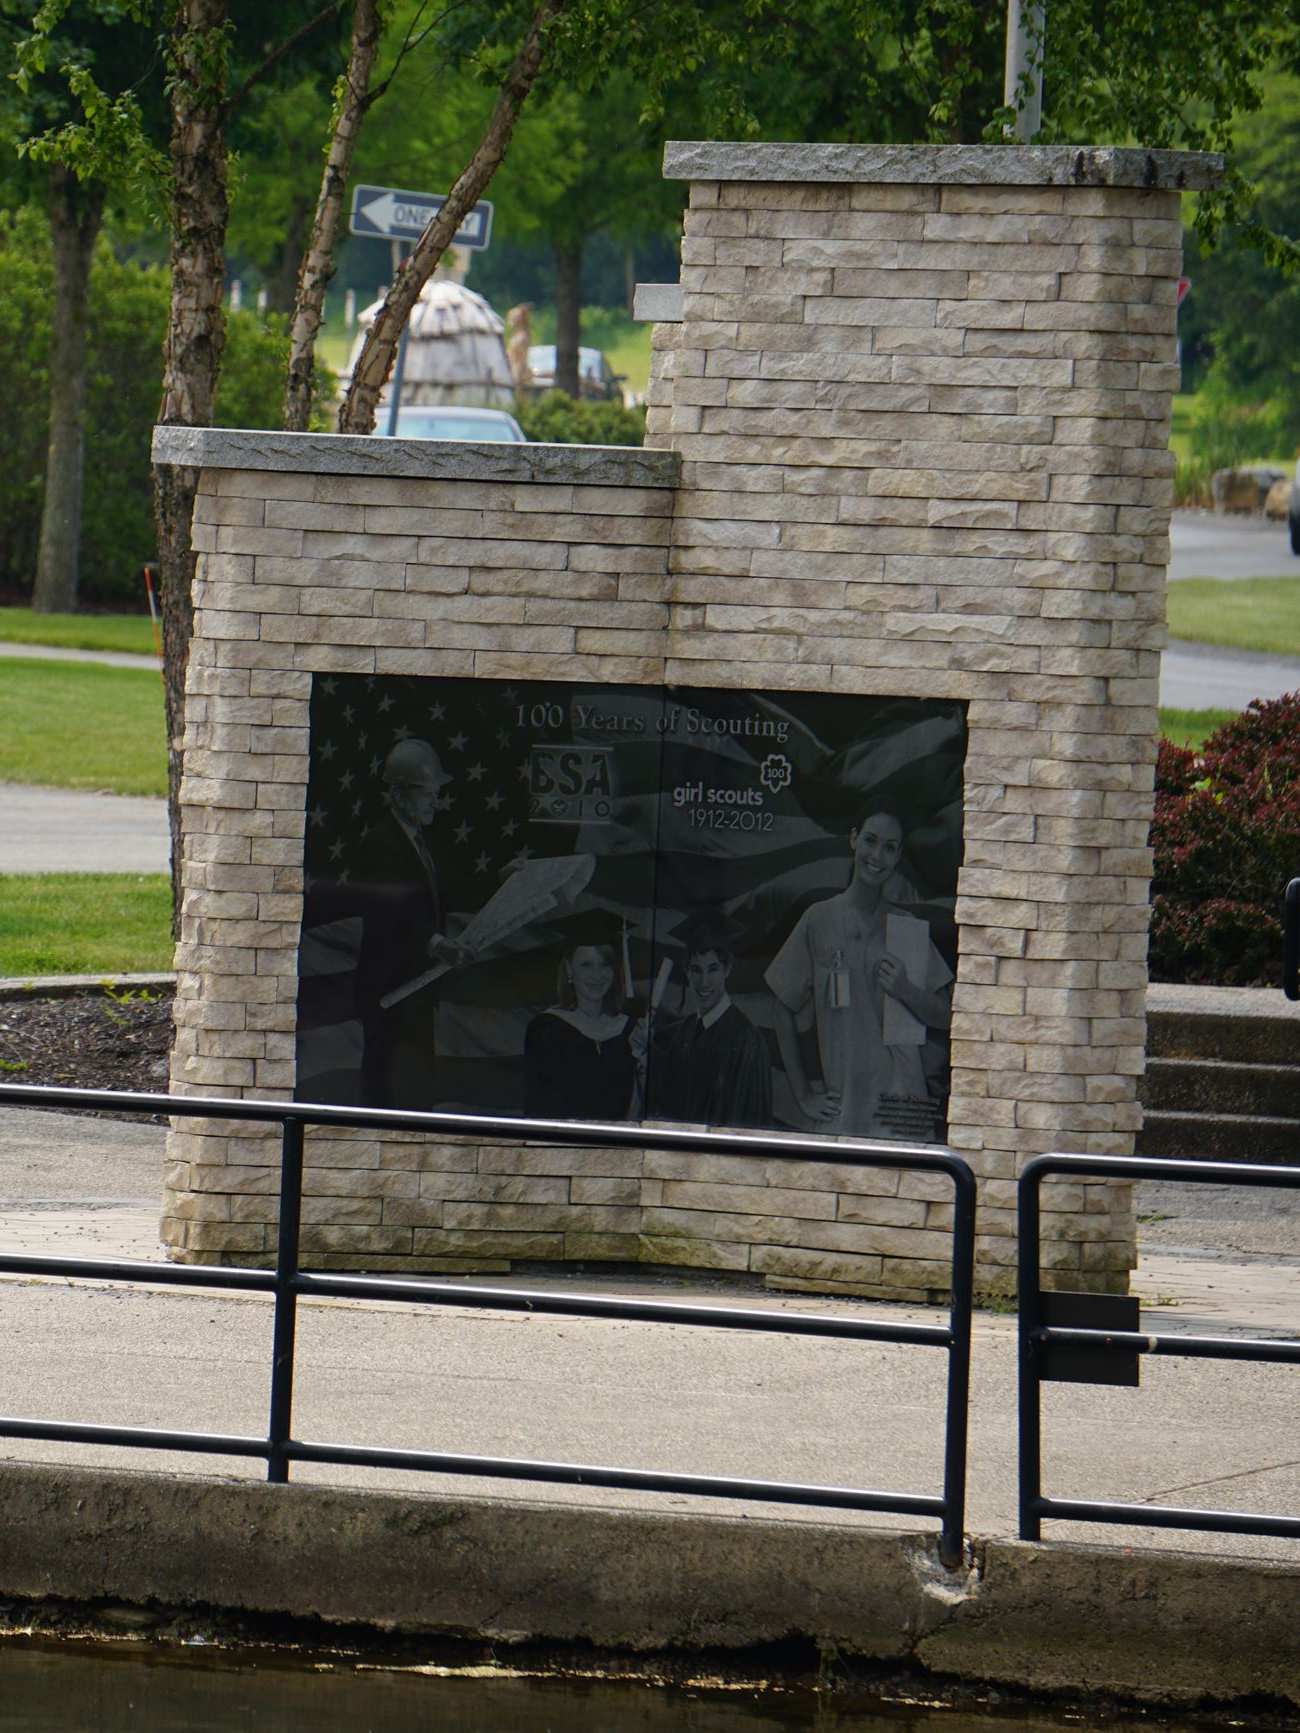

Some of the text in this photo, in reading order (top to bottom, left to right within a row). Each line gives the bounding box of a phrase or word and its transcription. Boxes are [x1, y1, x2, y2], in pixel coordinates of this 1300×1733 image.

[394, 205, 430, 225] ONE
[515, 703, 790, 743] 100 Years of Scouting
[530, 751, 612, 796] BSA
[766, 767, 785, 779] 100
[673, 782, 763, 807] girl scouts
[688, 809, 774, 832] 1912-2012
